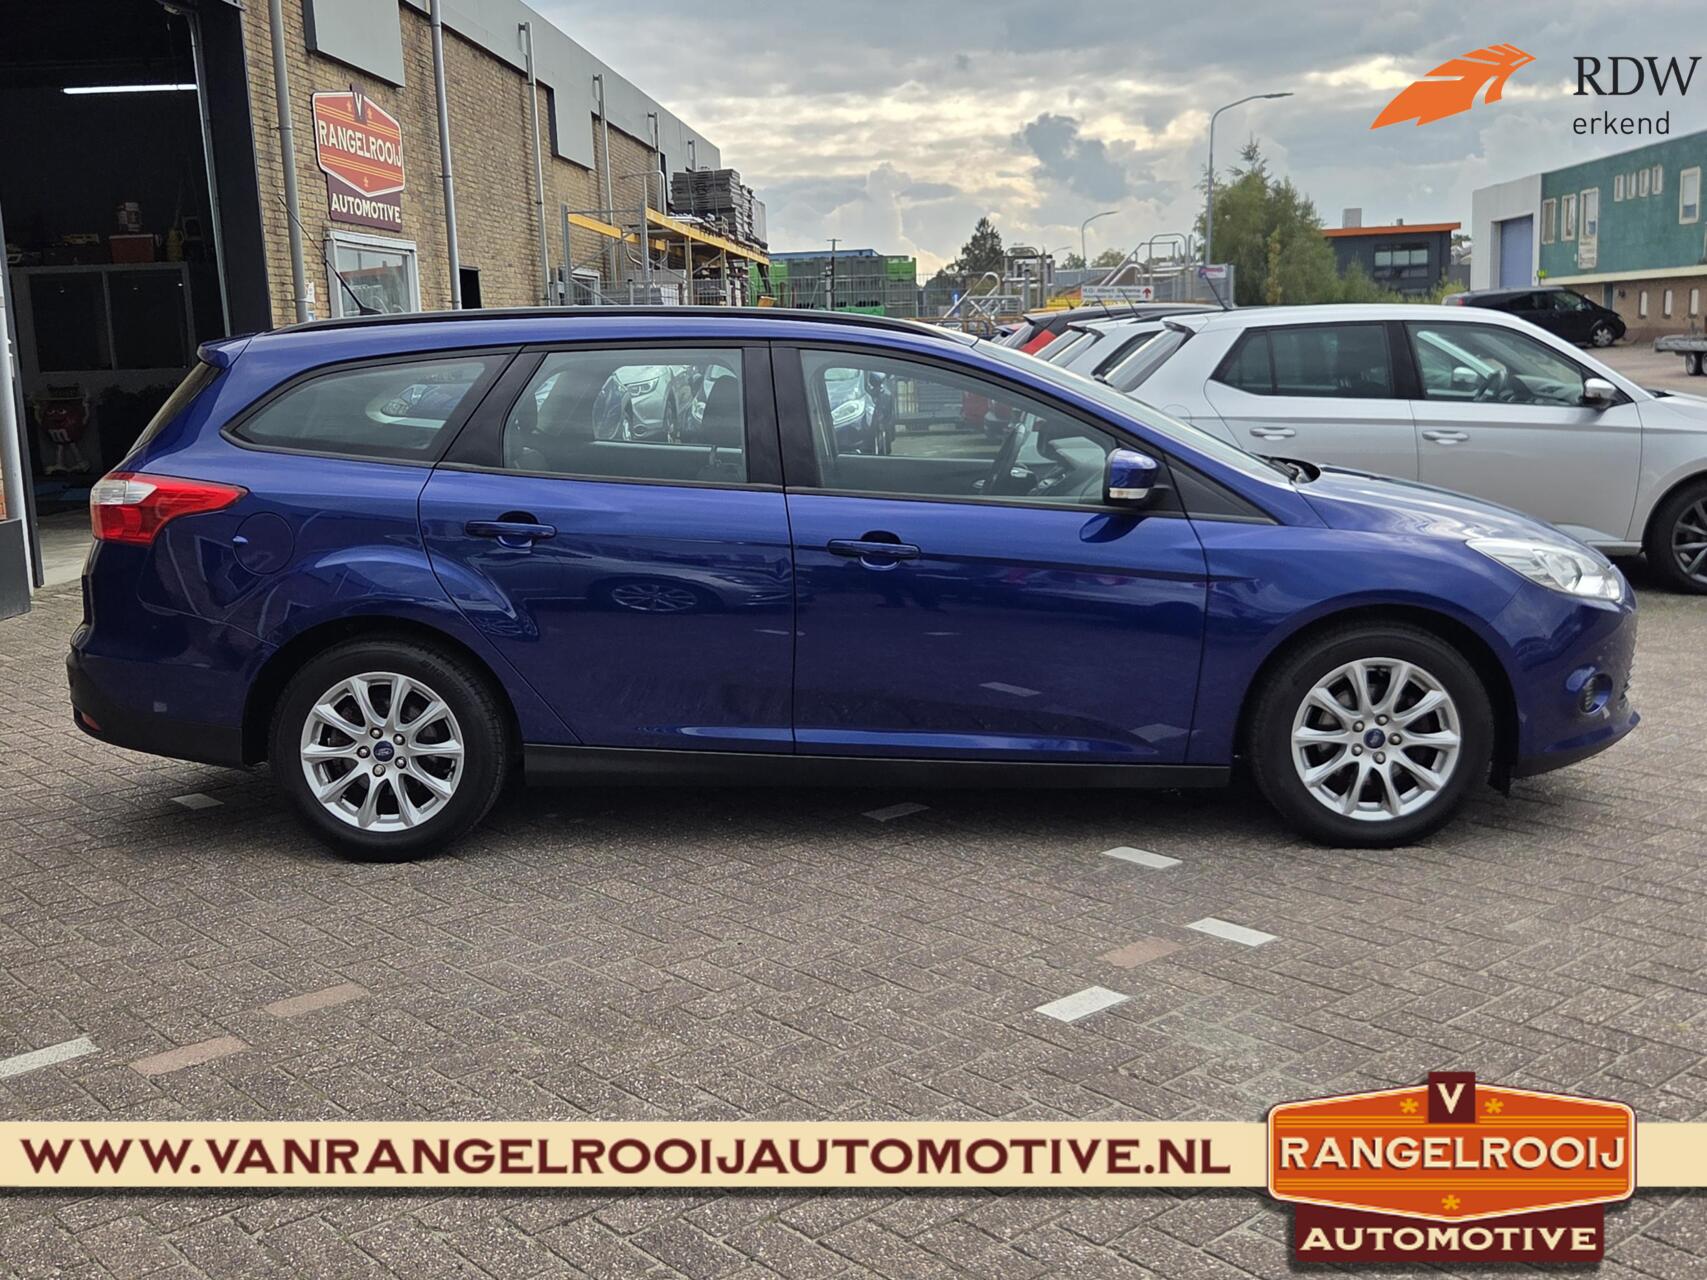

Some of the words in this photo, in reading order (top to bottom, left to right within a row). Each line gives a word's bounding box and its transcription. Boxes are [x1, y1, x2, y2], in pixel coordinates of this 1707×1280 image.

[354, 92, 363, 117] V
[317, 119, 402, 168] RANGELROOIJ
[331, 193, 402, 224] AUTOMOTIVE
